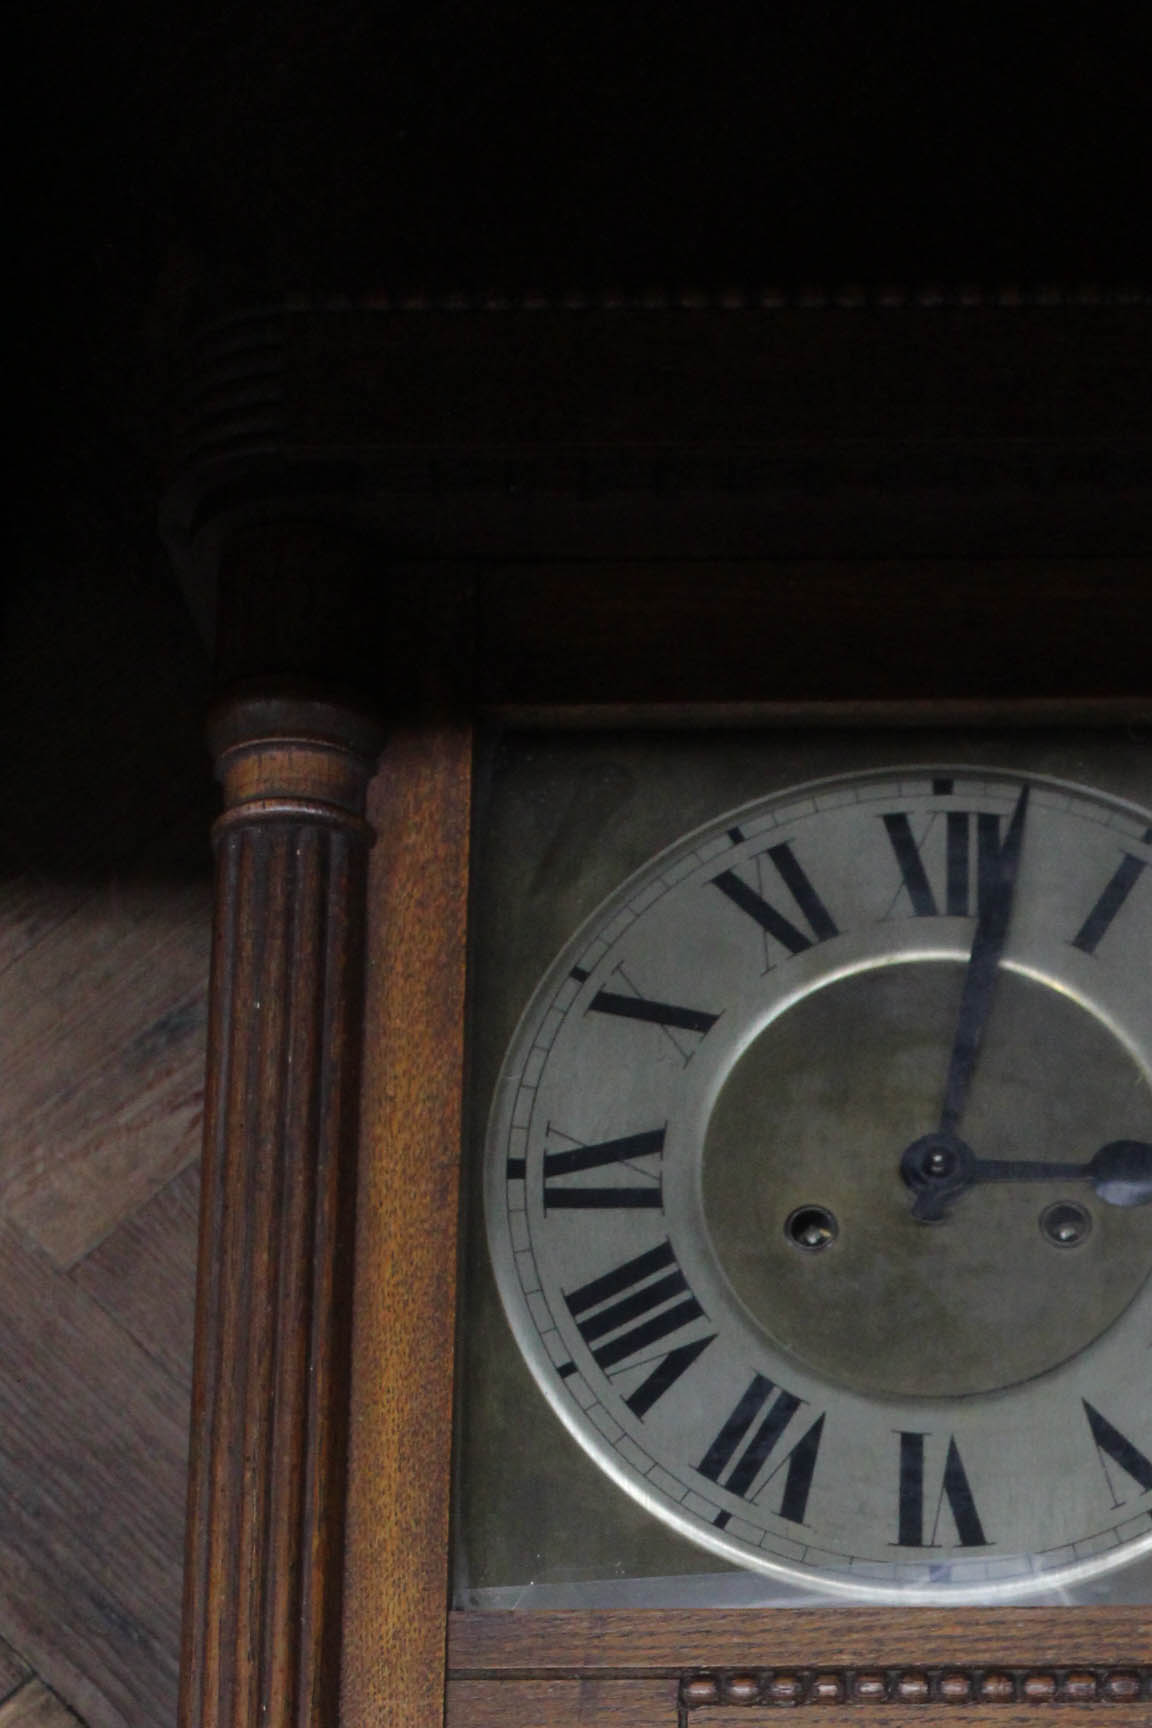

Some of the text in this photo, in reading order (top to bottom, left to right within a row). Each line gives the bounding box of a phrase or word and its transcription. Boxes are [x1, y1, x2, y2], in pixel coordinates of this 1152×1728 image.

[709, 841, 841, 975] XI
[587, 962, 726, 1069] X
[541, 1118, 669, 1219] IX
[561, 1238, 719, 1423] VIII
[690, 1371, 828, 1527] VII
[888, 1430, 997, 1549] VI
